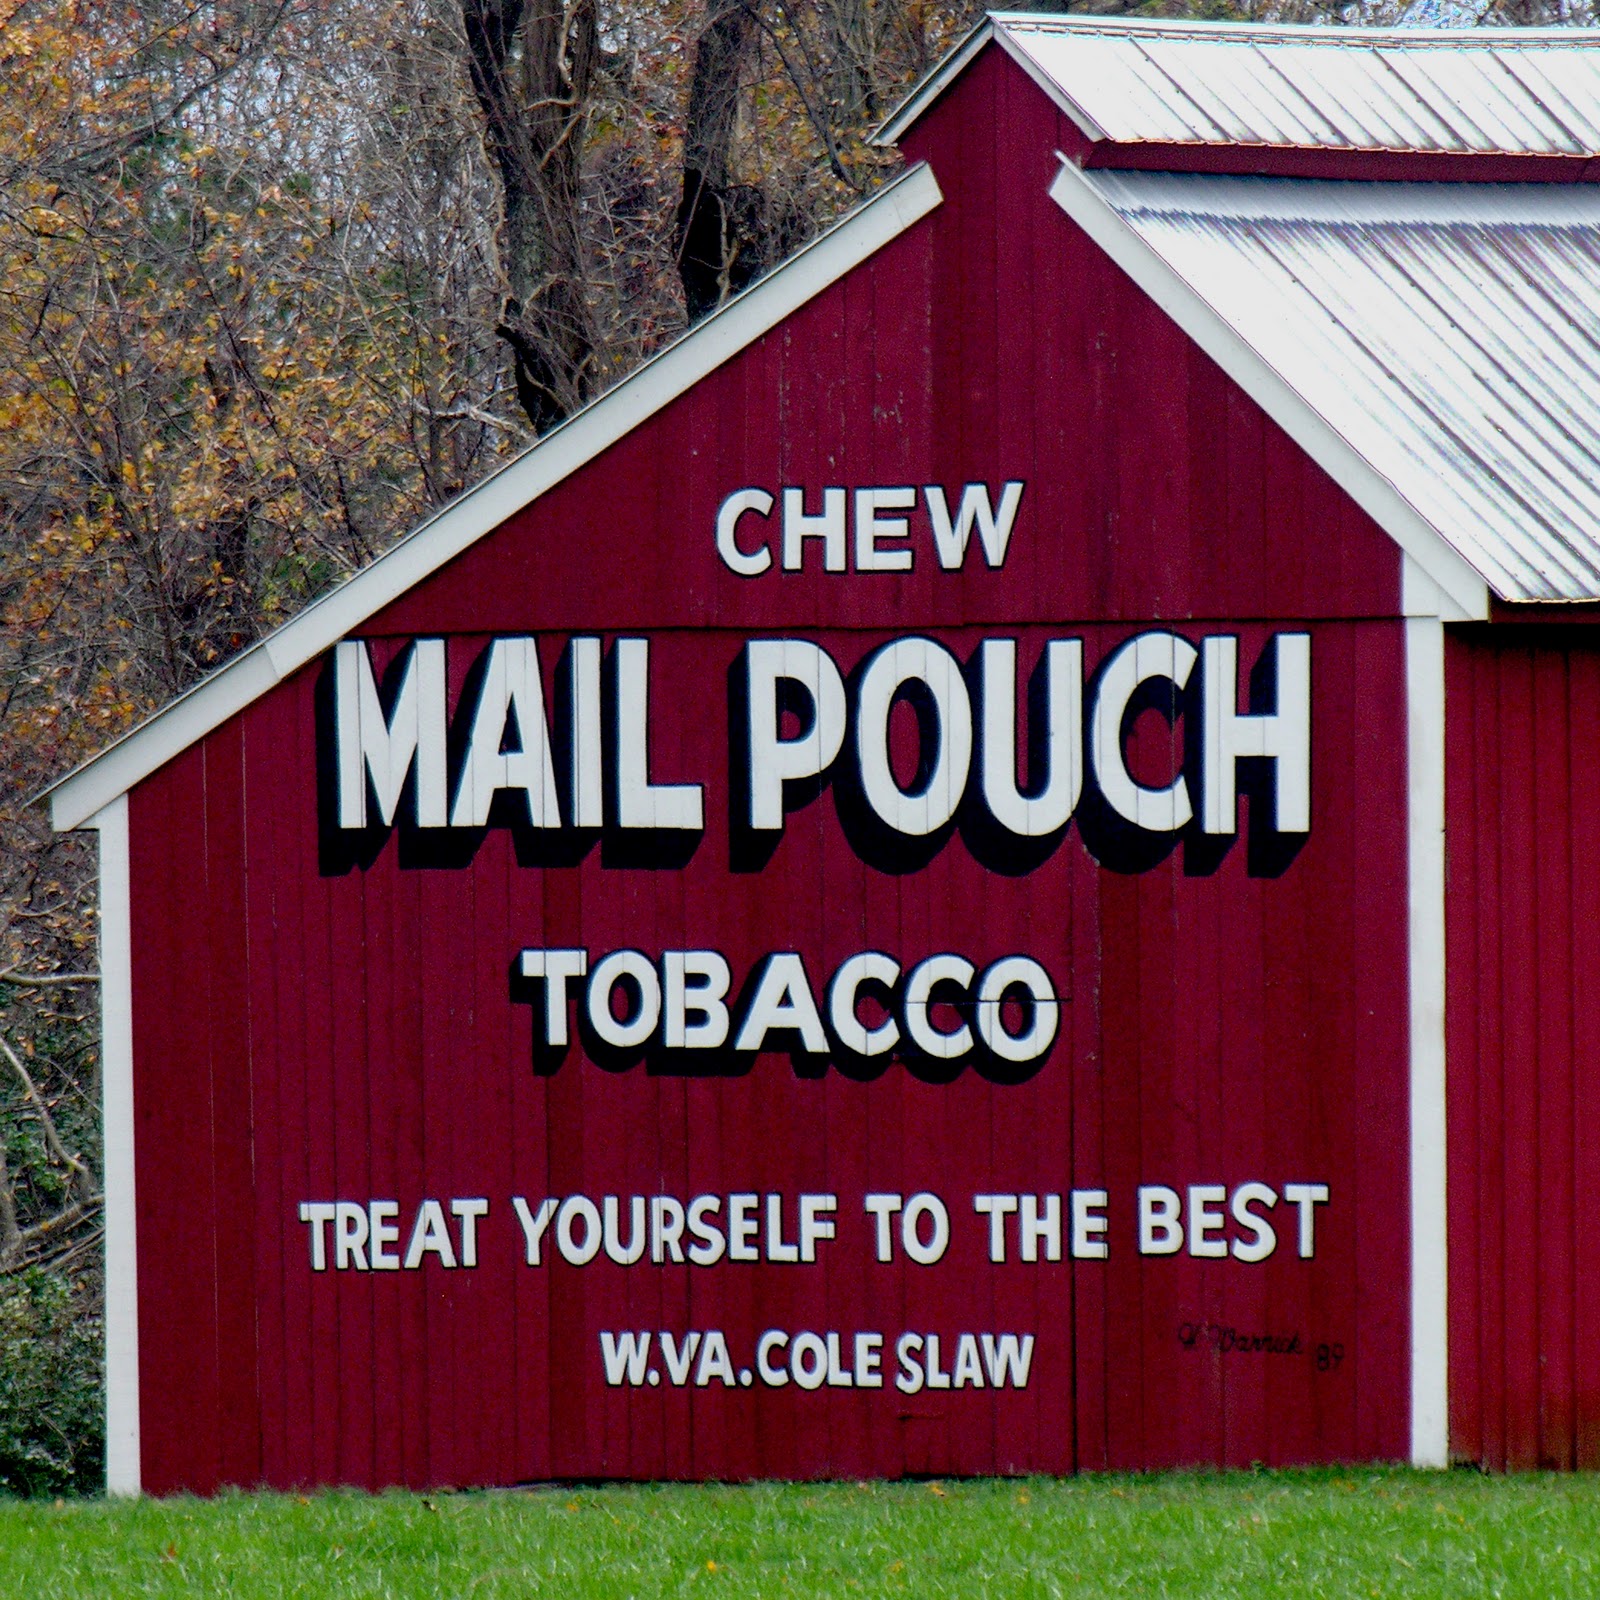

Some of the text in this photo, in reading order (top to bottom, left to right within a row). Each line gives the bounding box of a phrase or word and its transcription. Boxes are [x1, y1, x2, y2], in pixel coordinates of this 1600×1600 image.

[715, 481, 1024, 576] CHEW
[334, 632, 1312, 837] MAIL POUCH
[520, 949, 1059, 1064] TOBACCO
[298, 1182, 1330, 1270] TREAT YOURSELF TO THE BEST
[894, 1333, 1035, 1394] SLAW
